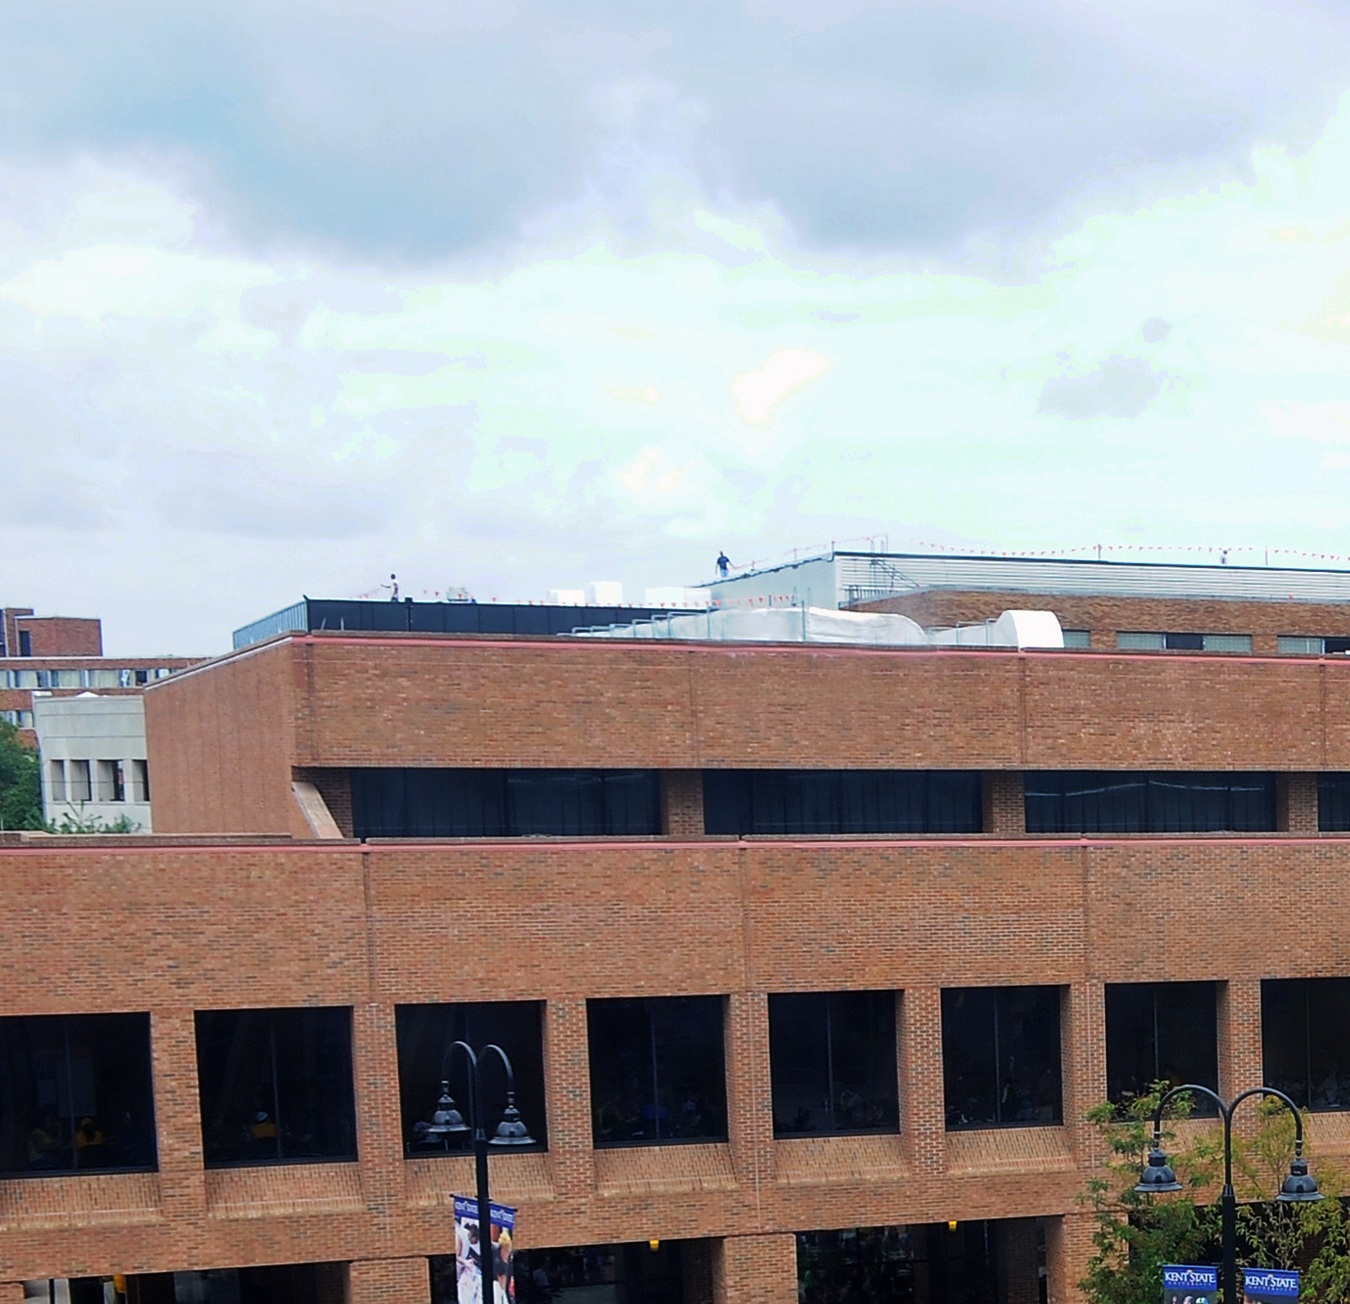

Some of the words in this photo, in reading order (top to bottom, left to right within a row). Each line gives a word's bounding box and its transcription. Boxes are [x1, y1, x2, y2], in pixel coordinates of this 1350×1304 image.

[1164, 1271, 1188, 1282] KENT
[1190, 1272, 1216, 1283] STATE
[1245, 1275, 1268, 1286] KENT
[1269, 1276, 1298, 1288] STATE
